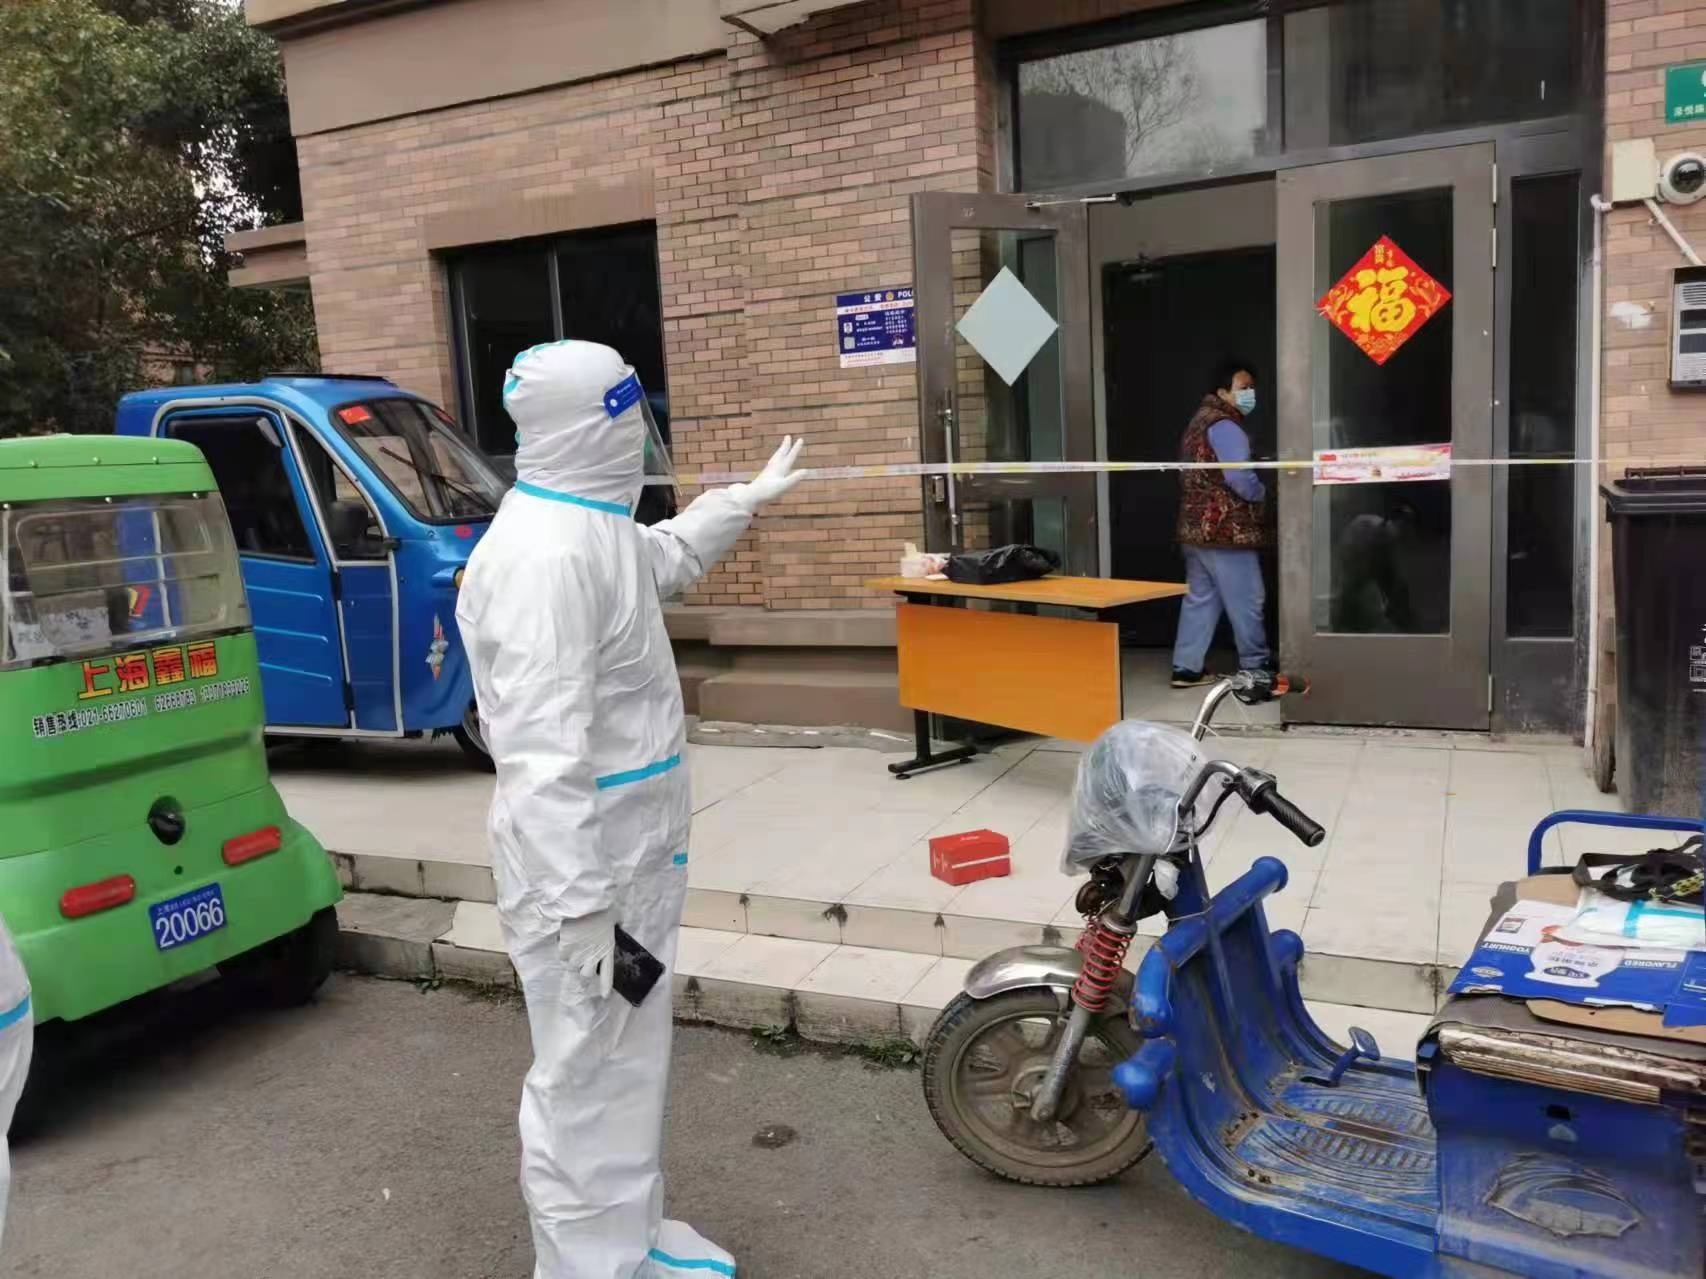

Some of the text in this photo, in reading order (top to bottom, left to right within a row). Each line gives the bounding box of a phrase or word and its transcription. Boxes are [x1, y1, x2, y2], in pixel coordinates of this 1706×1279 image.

[898, 290, 914, 298] POL
[1346, 266, 1417, 333] 福
[155, 897, 224, 949] 20066
[1624, 959, 1678, 969] FLAVORED
